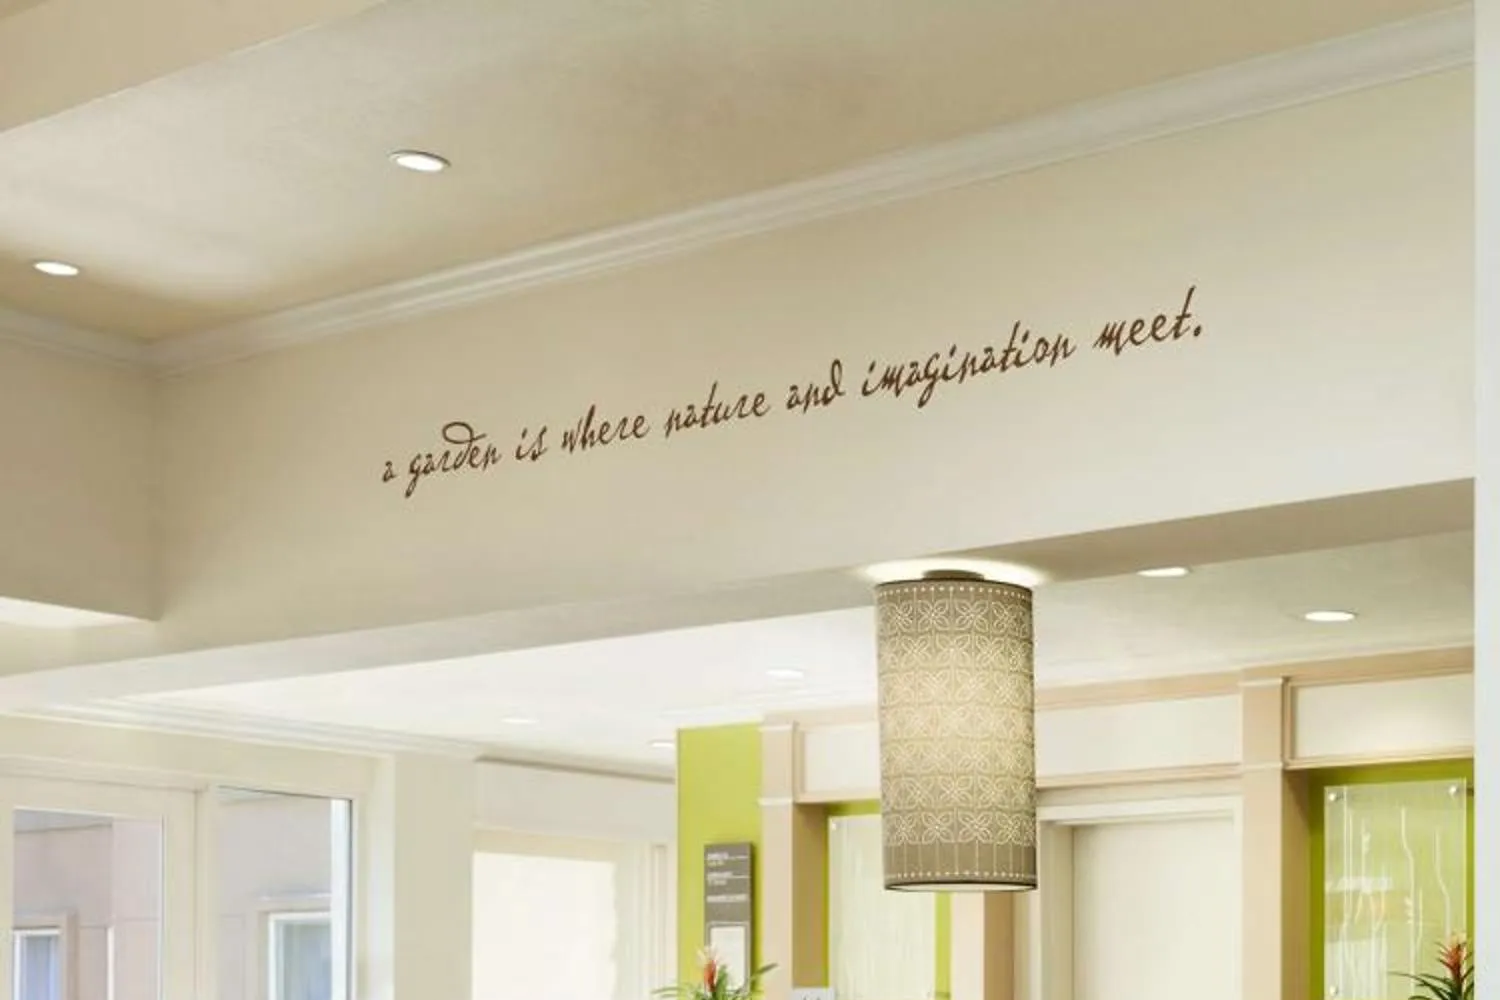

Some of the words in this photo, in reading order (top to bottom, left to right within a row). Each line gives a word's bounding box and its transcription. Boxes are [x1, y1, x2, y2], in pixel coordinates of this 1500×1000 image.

[382, 461, 396, 483] a
[405, 421, 500, 497] garden
[515, 429, 547, 462] is
[561, 405, 647, 450] where
[666, 382, 767, 436] nature
[786, 359, 845, 413] and
[861, 321, 1076, 409] imagination
[1094, 287, 1203, 356] meet.
